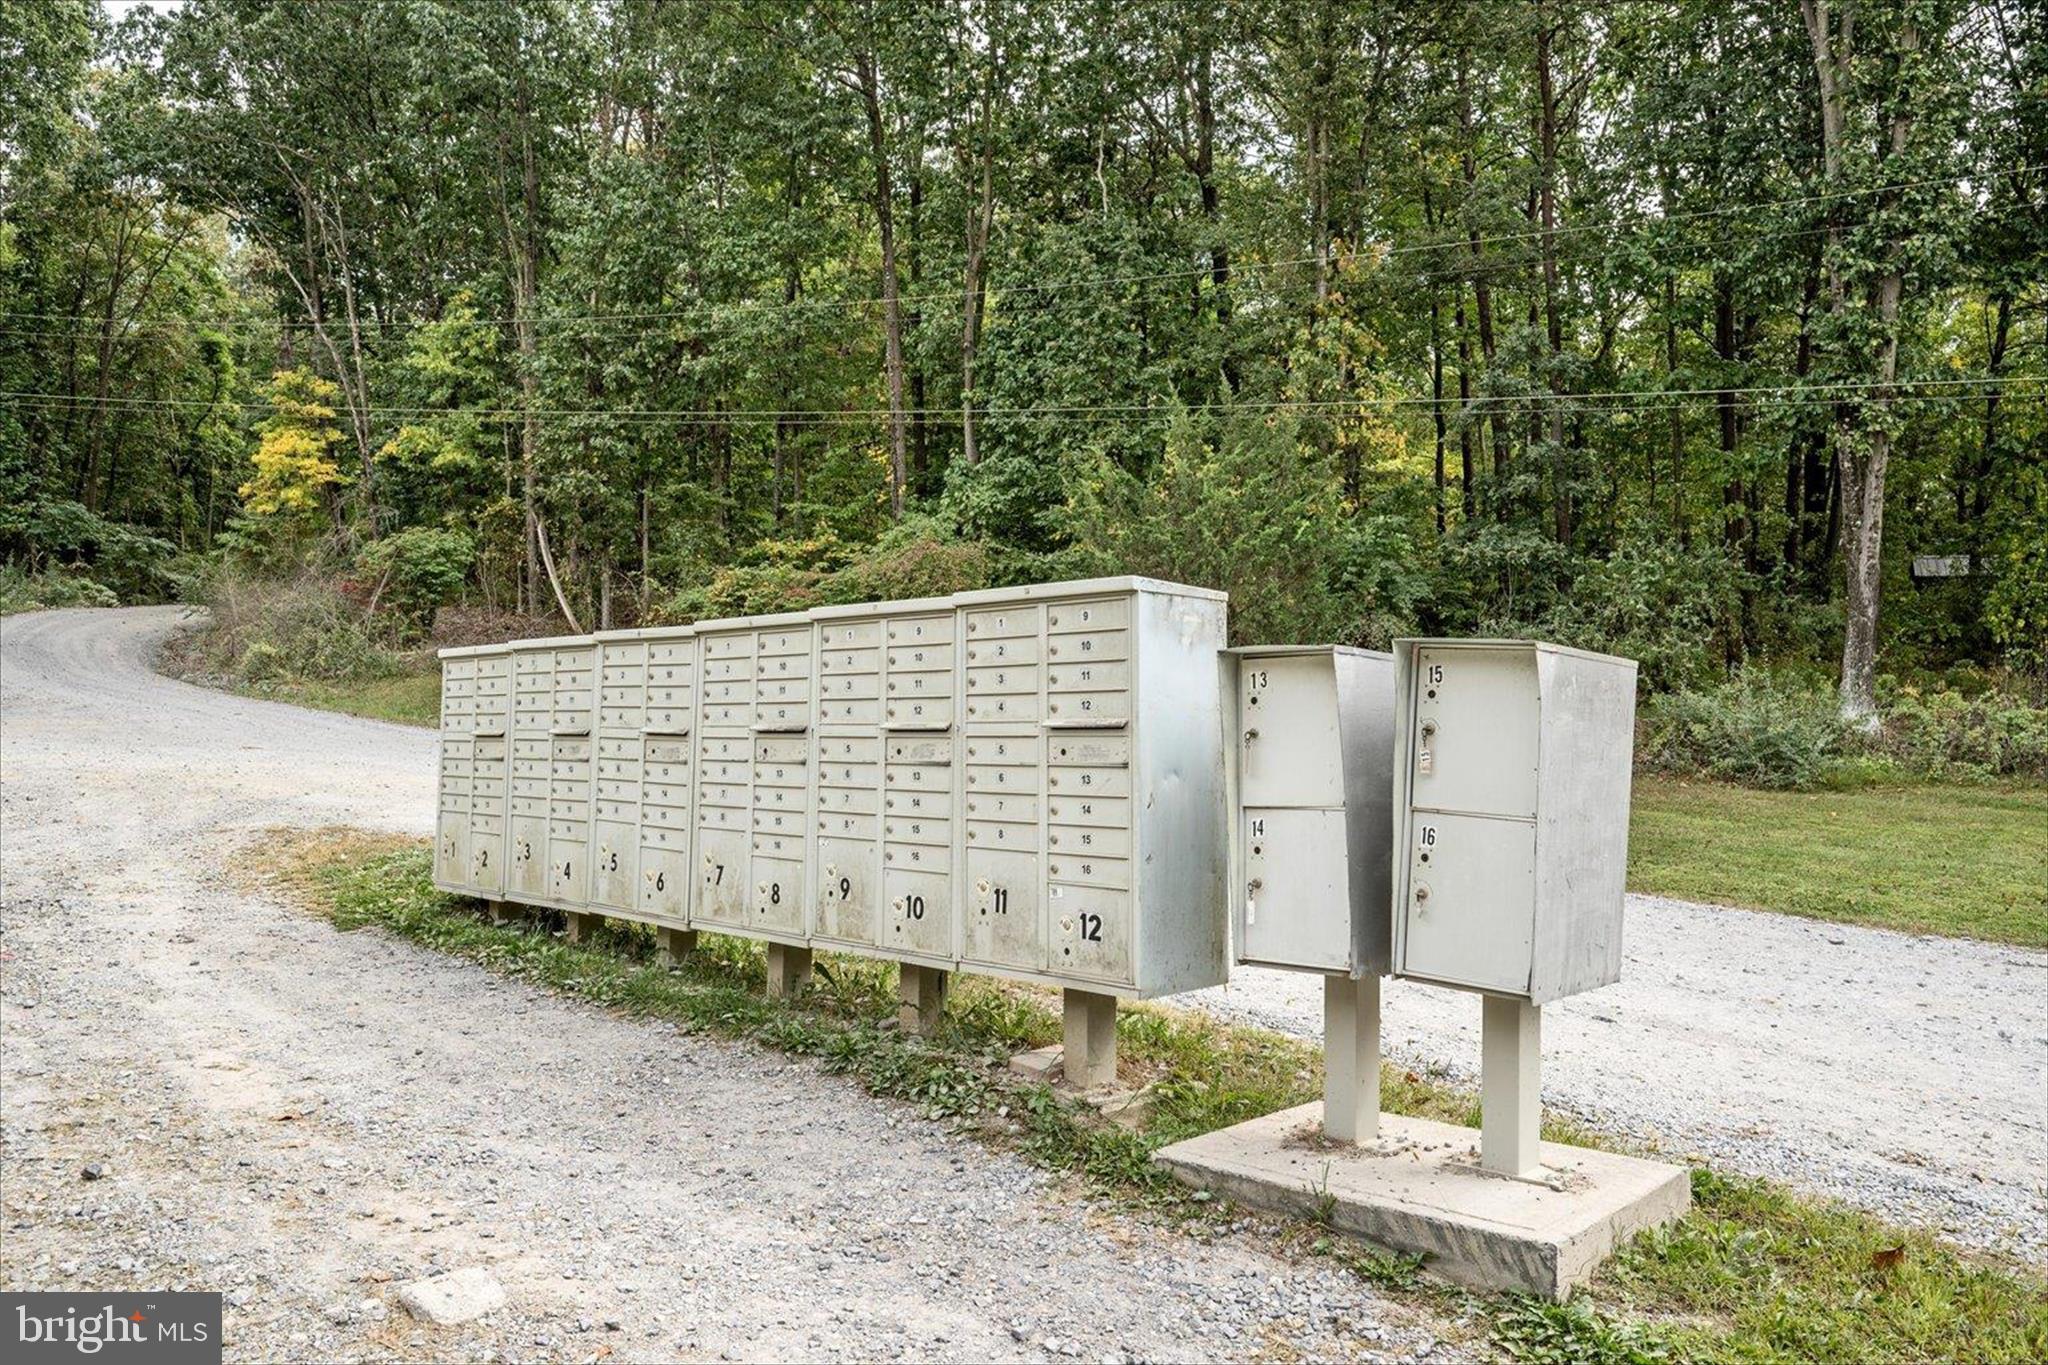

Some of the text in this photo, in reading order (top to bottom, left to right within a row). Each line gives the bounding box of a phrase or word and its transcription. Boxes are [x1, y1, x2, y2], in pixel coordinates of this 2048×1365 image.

[1083, 611, 1089, 621] 9
[998, 619, 1003, 627] 1
[848, 631, 852, 639] 1
[916, 626, 922, 636] 9
[1081, 640, 1091, 651] 10
[999, 646, 1004, 656] 2
[848, 656, 852, 665] 2
[914, 652, 923, 662] 10
[998, 674, 1004, 684] 3
[1081, 671, 1090, 680] 11
[1429, 665, 1443, 683] 15
[847, 681, 852, 690] 3
[914, 679, 922, 688] 11
[1251, 673, 1267, 688] 13
[998, 703, 1004, 711] 4
[1081, 700, 1091, 710] 12
[914, 706, 922, 715] 12
[846, 744, 851, 753] 5
[999, 744, 1004, 755] 5
[845, 769, 850, 778] 6
[913, 771, 921, 781] 13
[999, 773, 1004, 783] 6
[1081, 774, 1091, 785] 13
[845, 794, 850, 803] 7
[912, 798, 920, 807] 14
[999, 801, 1004, 810] 7
[1082, 805, 1091, 814] 14
[844, 820, 849, 829] 8
[912, 824, 920, 834] 15
[1252, 820, 1264, 836] 14
[998, 829, 1004, 839] 8
[1422, 827, 1436, 845] 16
[1082, 834, 1092, 845] 15
[452, 842, 455, 857] 1
[524, 843, 531, 860] 3
[482, 851, 488, 867] 2
[911, 852, 920, 861] 16
[610, 854, 617, 871] 5
[564, 862, 570, 880] 4
[1082, 864, 1092, 875] 16
[716, 865, 724, 885] 7
[657, 872, 664, 891] 6
[771, 883, 780, 904] 8
[840, 878, 850, 900] 9
[994, 888, 1007, 914] 11
[906, 895, 924, 920] 10
[1080, 913, 1102, 941] 12
